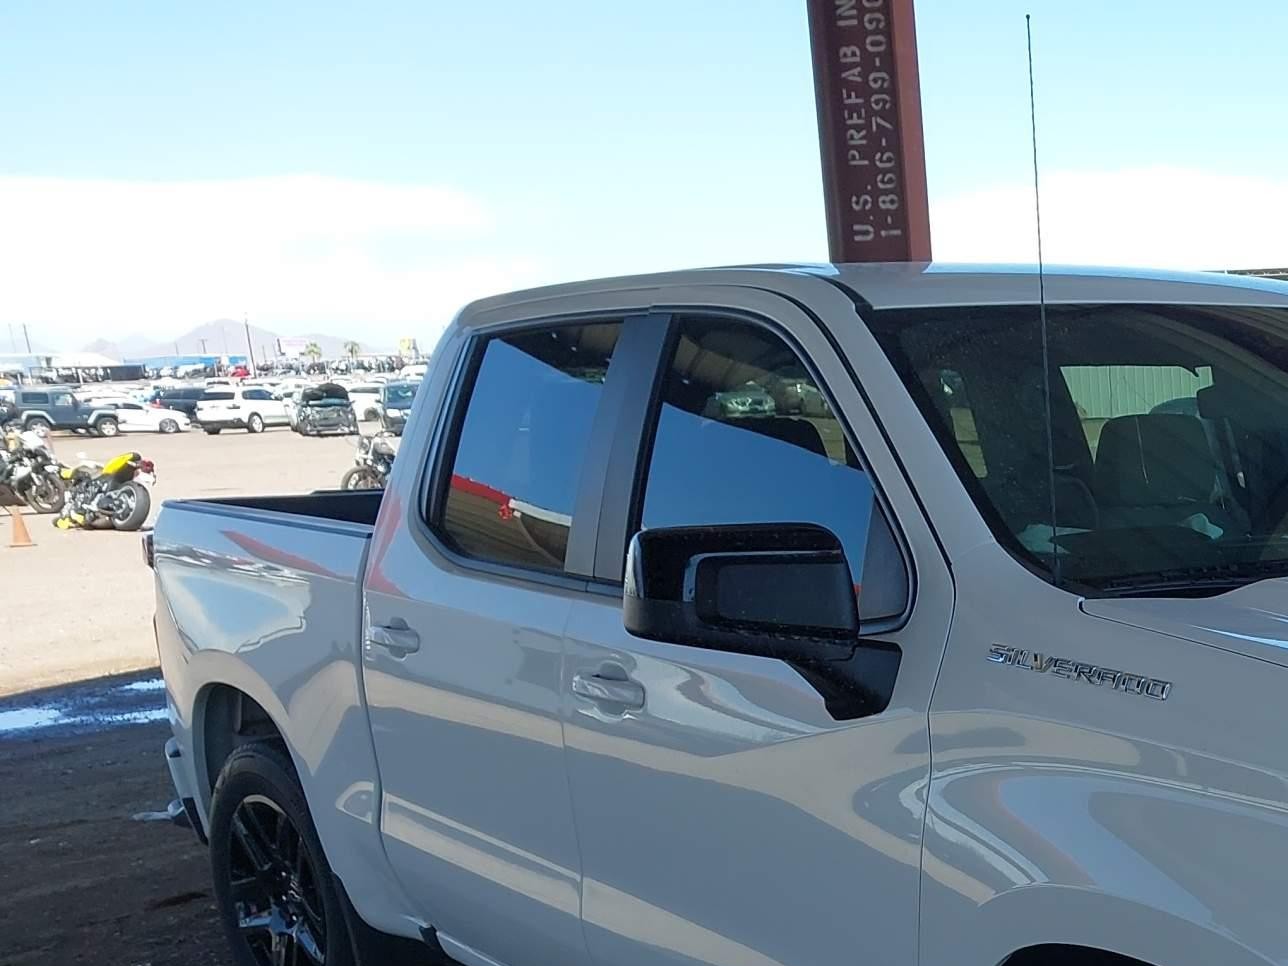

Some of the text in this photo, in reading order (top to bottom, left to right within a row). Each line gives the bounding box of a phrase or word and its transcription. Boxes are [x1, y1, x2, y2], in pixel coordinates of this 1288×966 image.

[839, 44, 869, 166] PREFAB
[852, 184, 875, 242] U.S.
[986, 643, 1173, 701] SILVERADO
